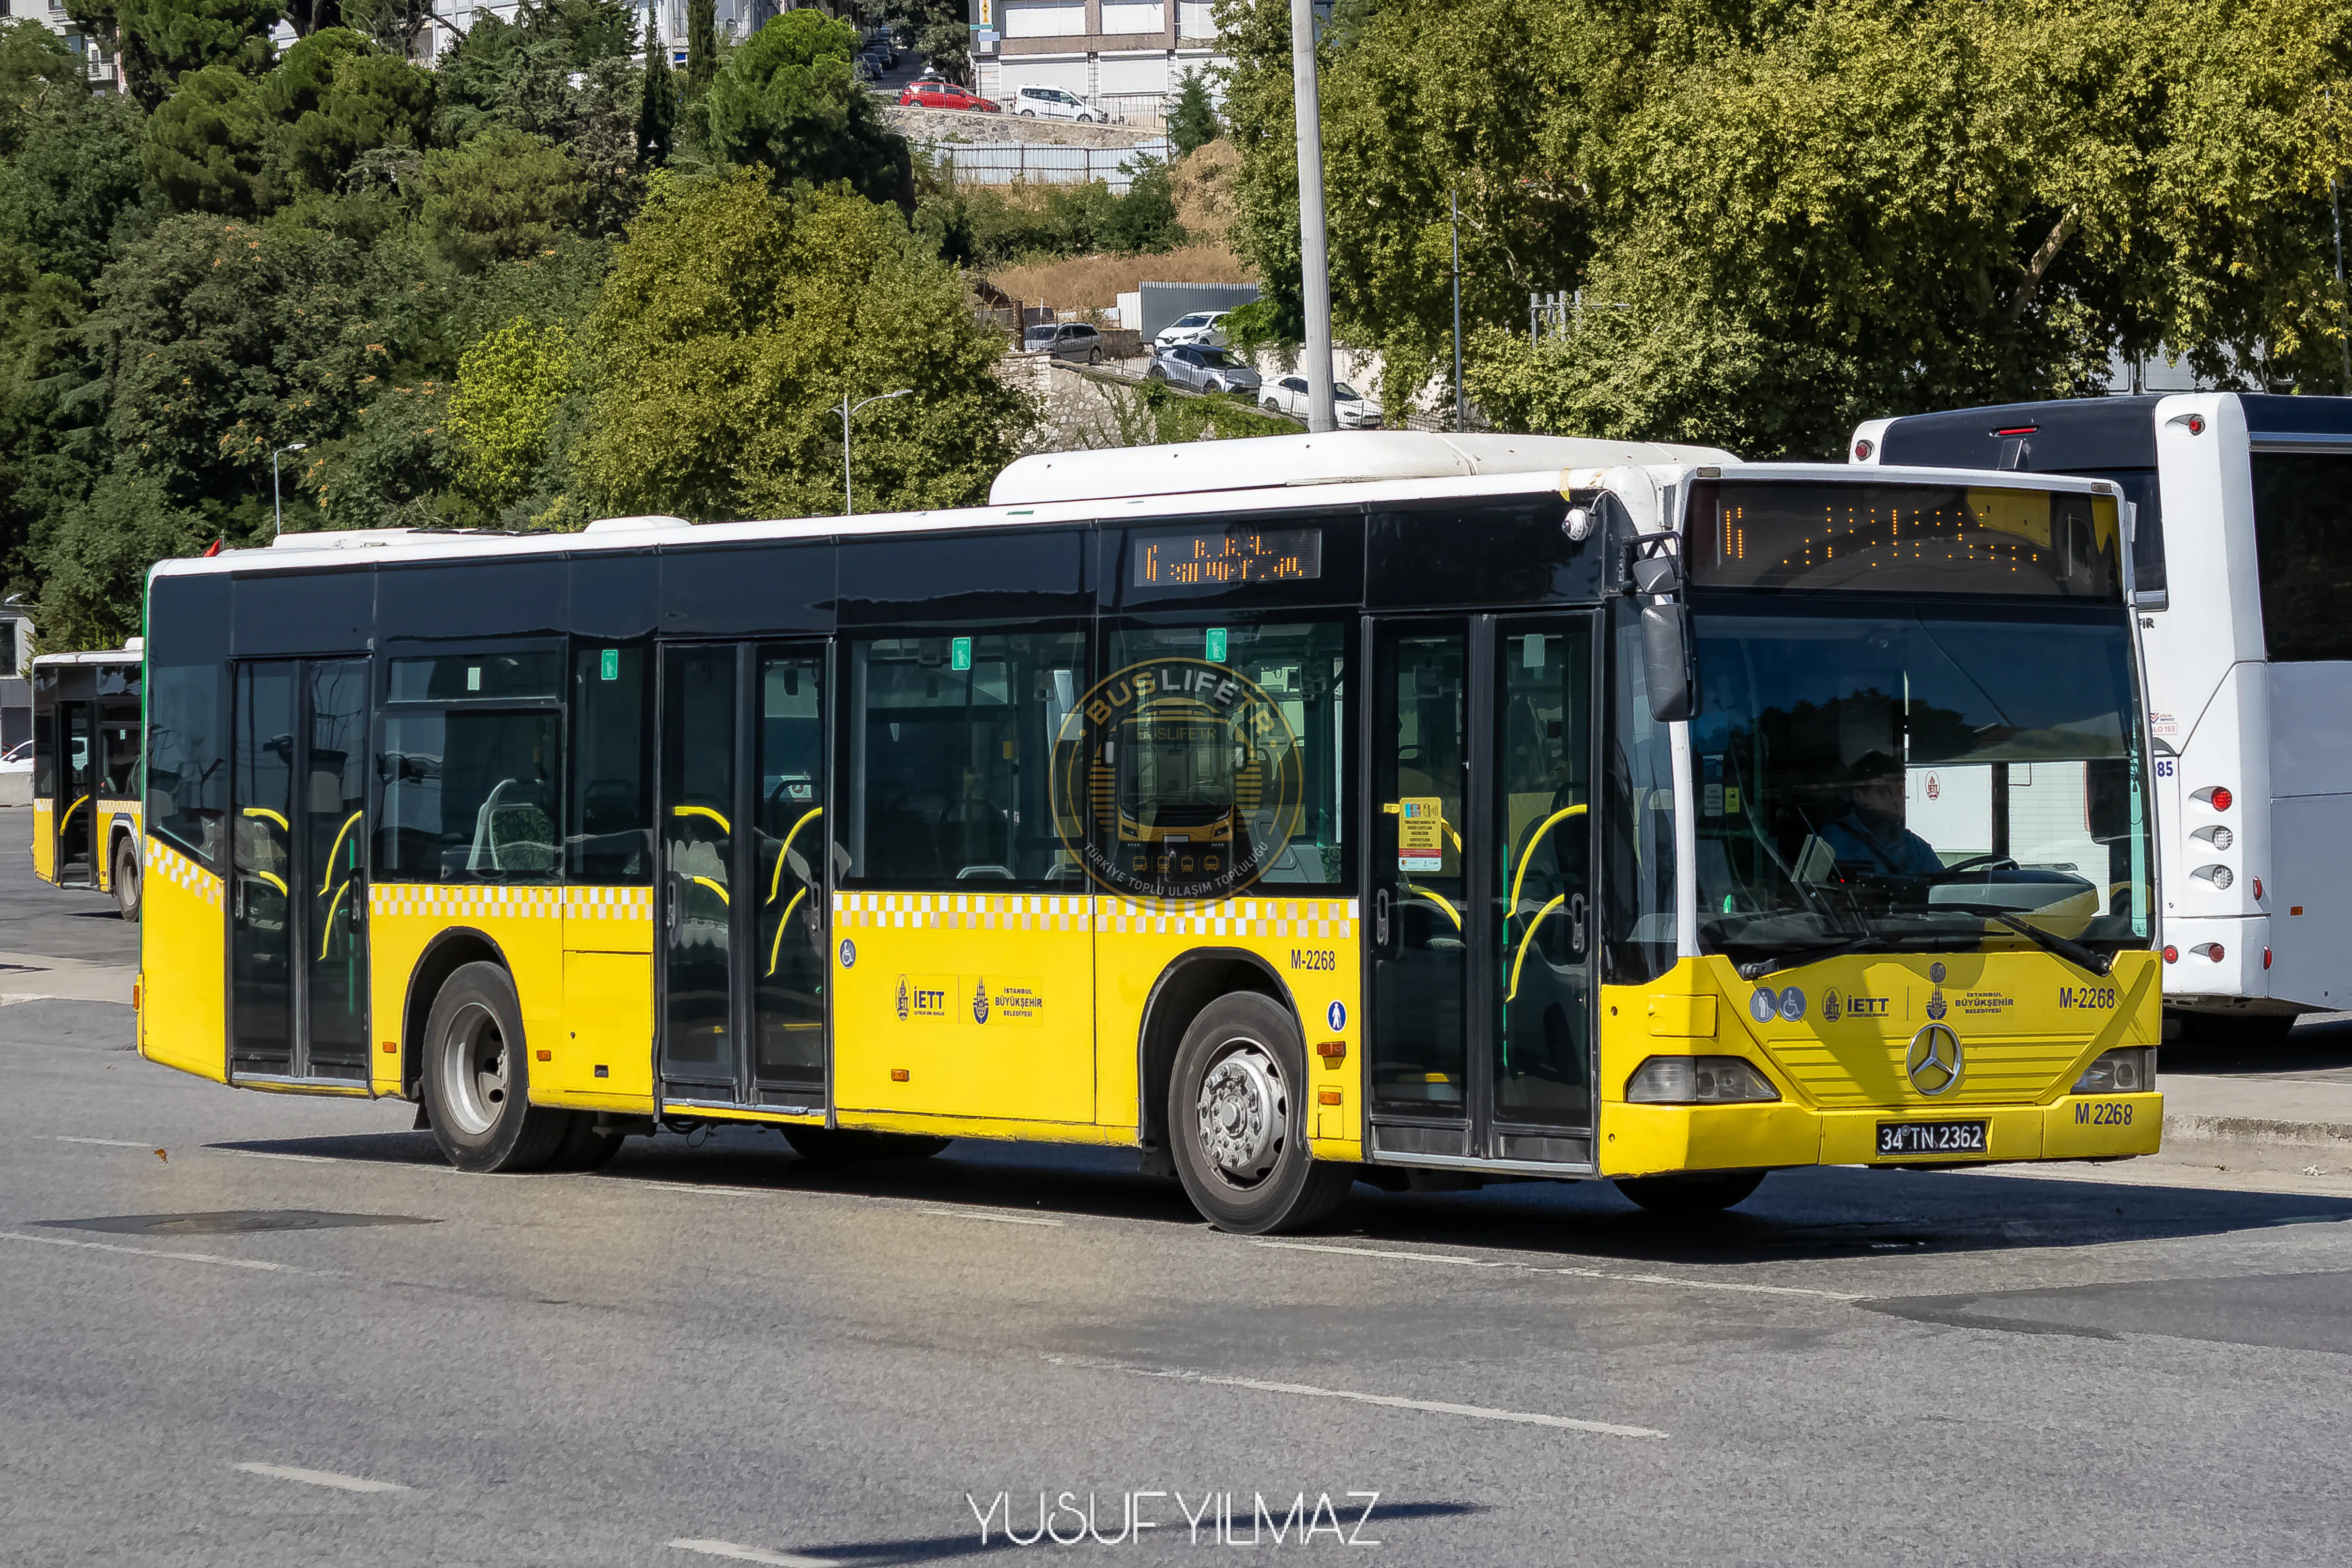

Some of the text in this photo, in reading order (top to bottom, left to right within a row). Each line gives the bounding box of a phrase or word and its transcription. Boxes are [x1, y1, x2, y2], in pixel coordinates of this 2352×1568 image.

[1291, 949, 1336, 971] M-2268
[914, 986, 944, 1009] İETT
[1004, 986, 1032, 995] İSTANBUL
[2060, 987, 2115, 1009] M-2268
[995, 995, 1042, 1009] BÜYÜKŞEHİR
[1847, 995, 1889, 1013] İETT
[1955, 998, 2014, 1008] BÜYÜKŞEHİR
[2075, 1103, 2133, 1125] M 2268
[1882, 1126, 1982, 1150] 34 TN 2362
